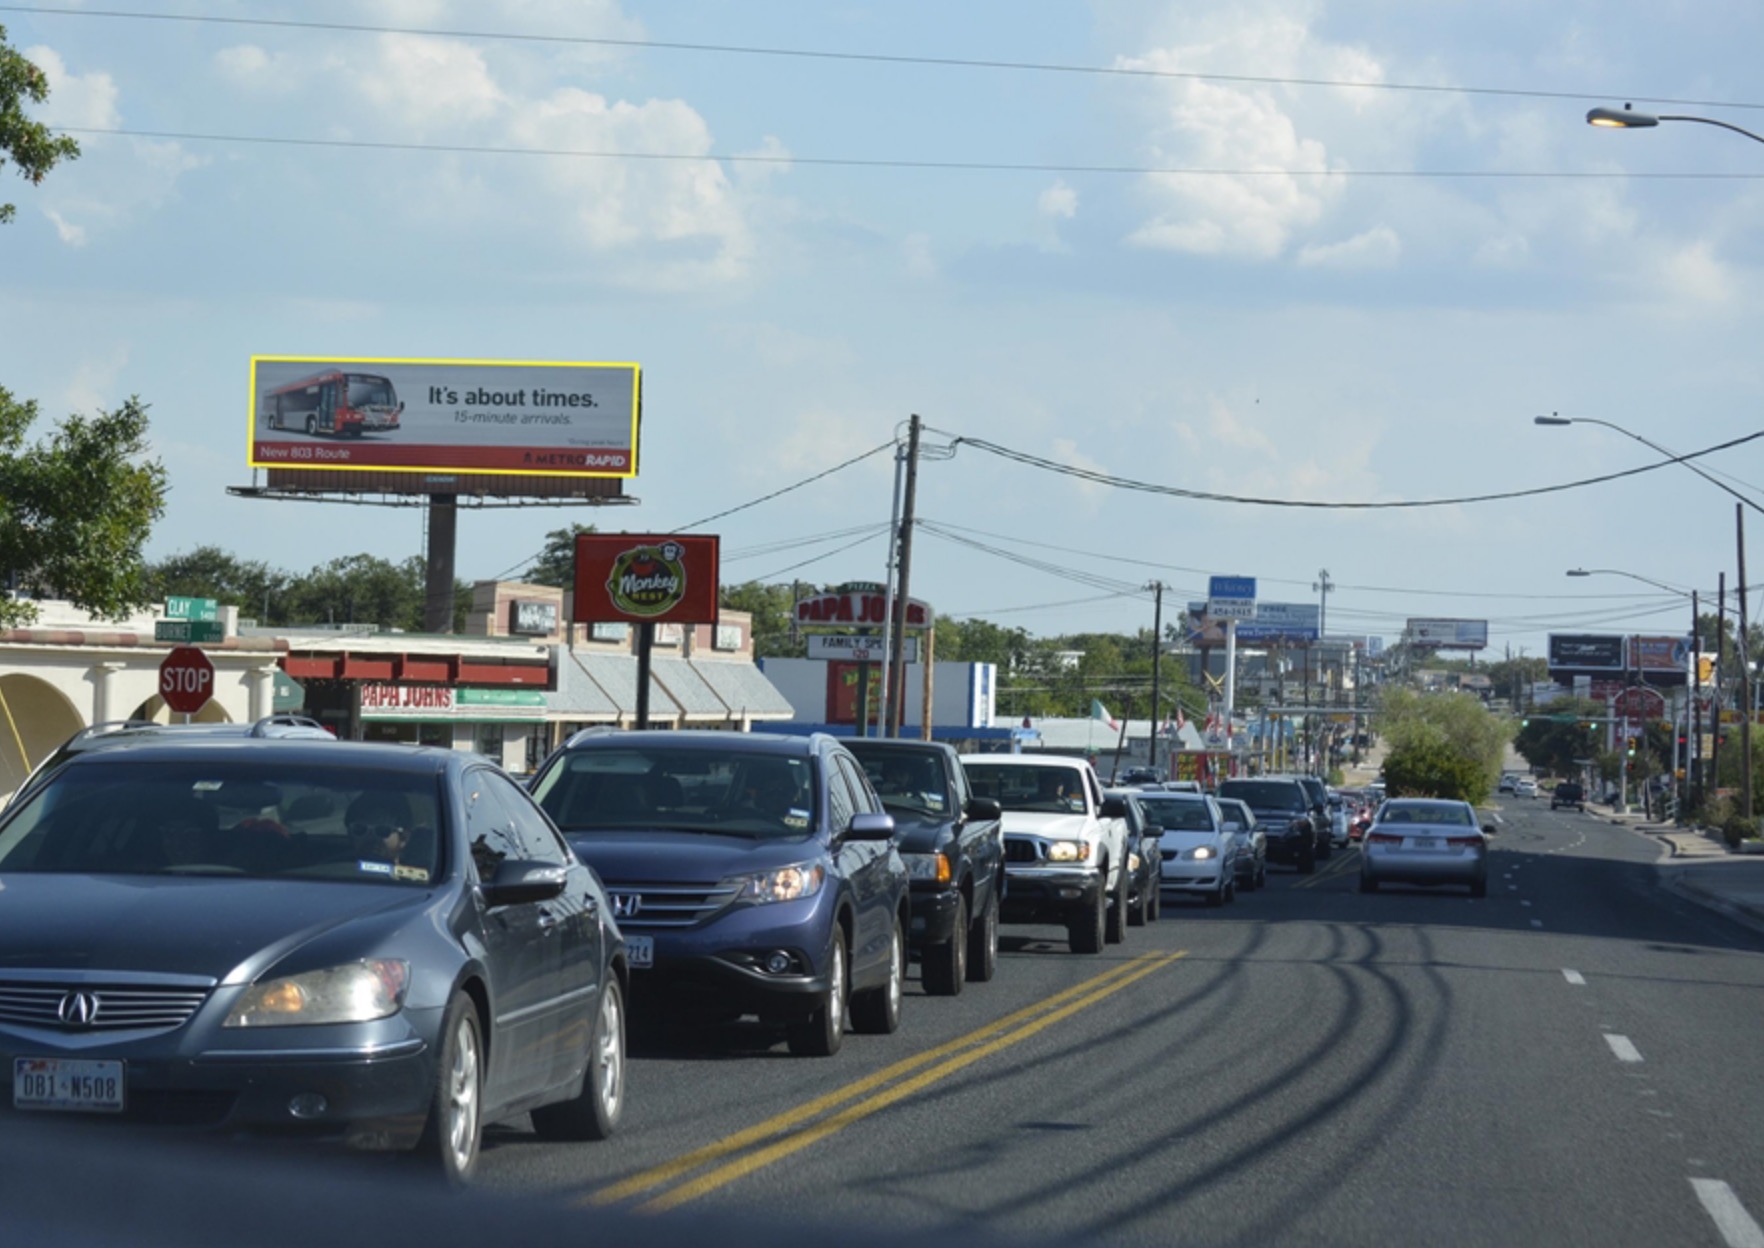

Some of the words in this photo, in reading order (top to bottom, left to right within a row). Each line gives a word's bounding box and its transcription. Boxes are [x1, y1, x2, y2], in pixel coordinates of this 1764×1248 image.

[429, 386, 458, 405] It's
[464, 387, 526, 407] about
[532, 388, 599, 409] times.
[453, 410, 518, 425] 15-minute
[520, 411, 573, 426] arrivals.
[260, 446, 288, 459] New
[291, 447, 313, 459] 803
[315, 447, 350, 460] Route
[618, 573, 679, 596] Monkey
[847, 582, 877, 592] PIZZA
[631, 591, 664, 600] NEST
[168, 599, 191, 617] CLAY
[798, 595, 854, 622] PAPA
[822, 637, 860, 649] FAMILY
[162, 667, 211, 693] STOP
[361, 685, 400, 707] PAPA
[403, 686, 452, 709] JOHNS
[71, 1075, 117, 1100] N508
